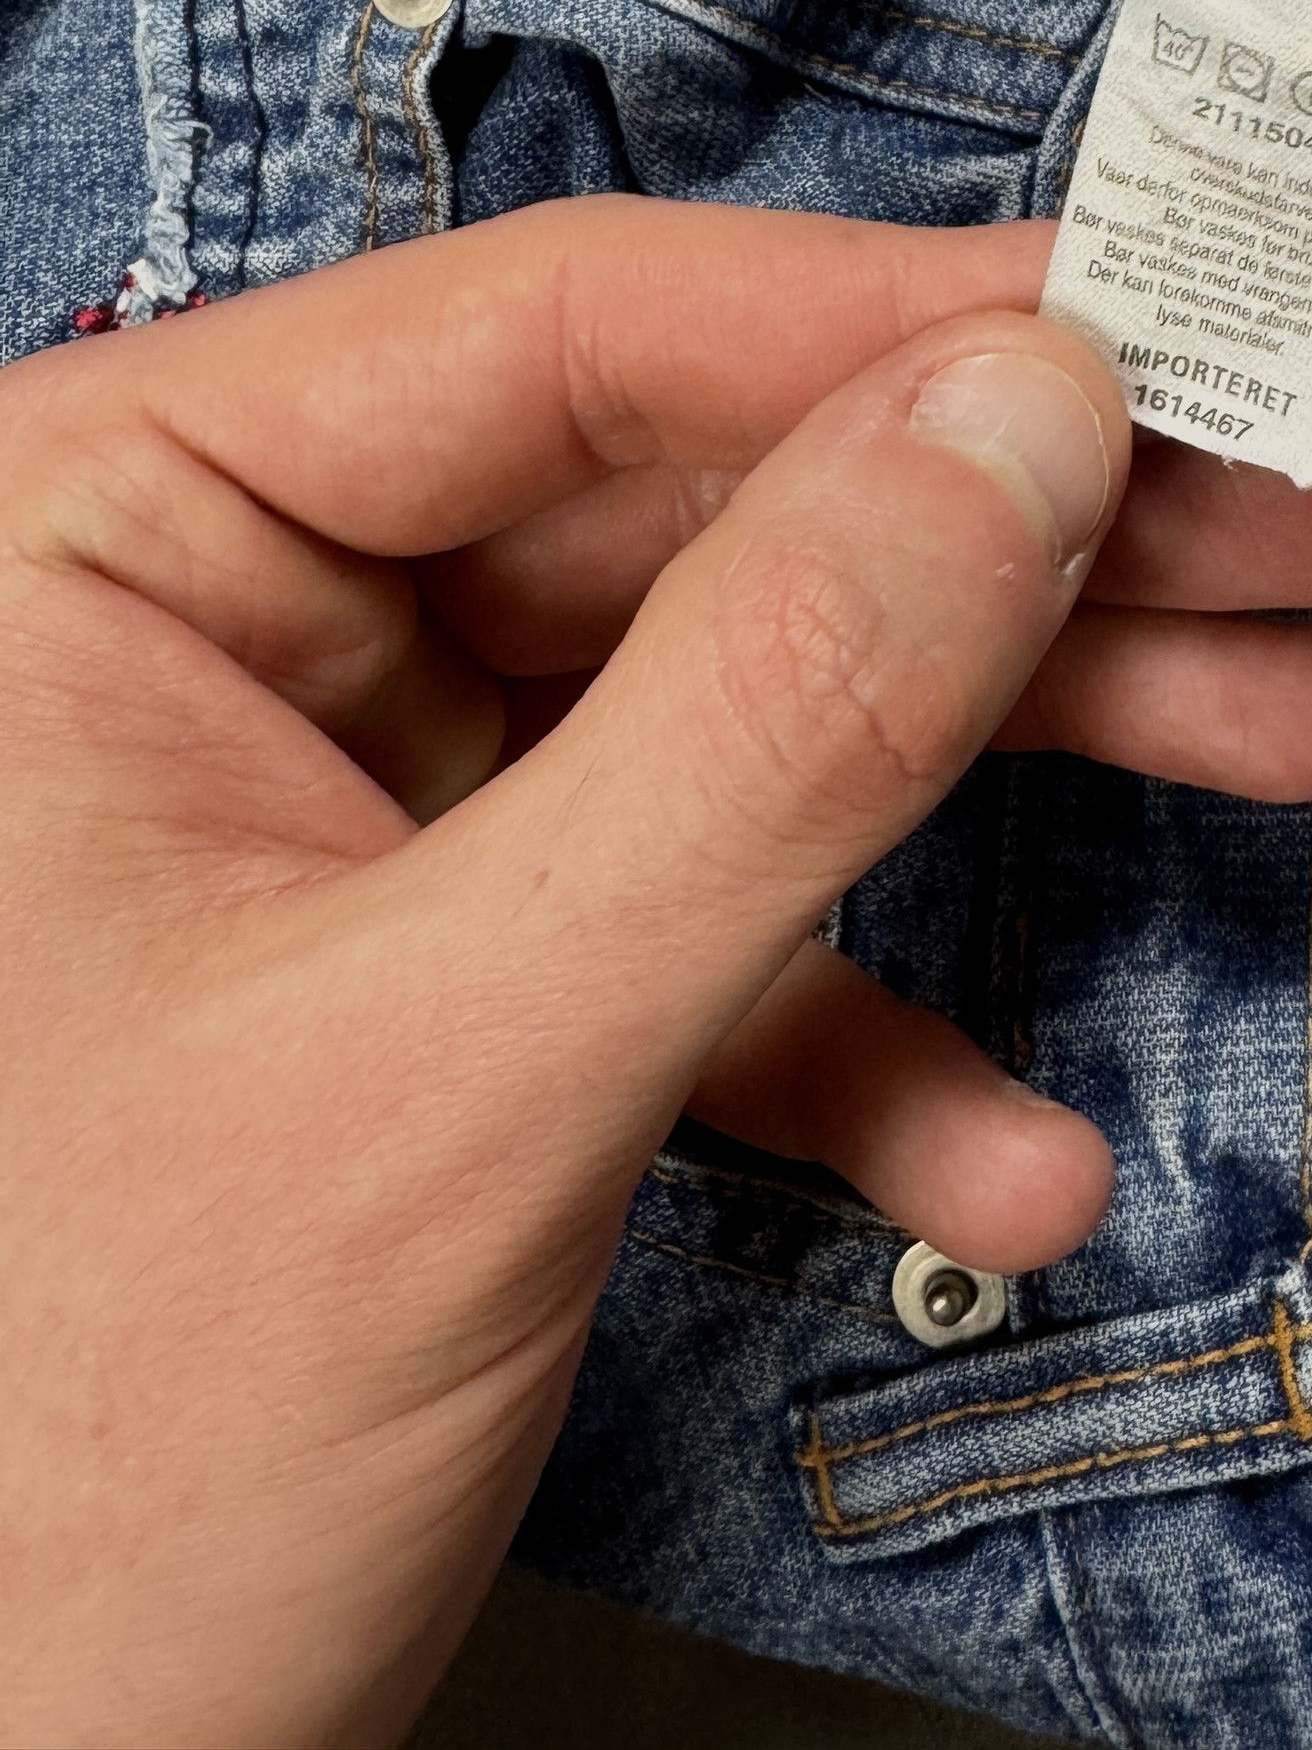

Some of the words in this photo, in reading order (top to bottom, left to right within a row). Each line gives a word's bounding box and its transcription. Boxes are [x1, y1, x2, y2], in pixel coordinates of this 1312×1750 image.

[1246, 162, 1279, 187] kan
[1106, 219, 1166, 247] vaskes
[1170, 236, 1235, 266] separat
[1237, 254, 1259, 274] de
[1199, 219, 1258, 248] vaskes
[1087, 259, 1120, 285] Der
[1121, 268, 1153, 294] kan
[1157, 278, 1252, 321] forekomme
[1138, 253, 1198, 280] vaskes
[1201, 270, 1241, 292] med
[1242, 281, 1312, 313] vrangen
[1155, 303, 1193, 327] lyse
[1118, 342, 1297, 417] IMPORTERET
[1134, 384, 1255, 441] 1614467
